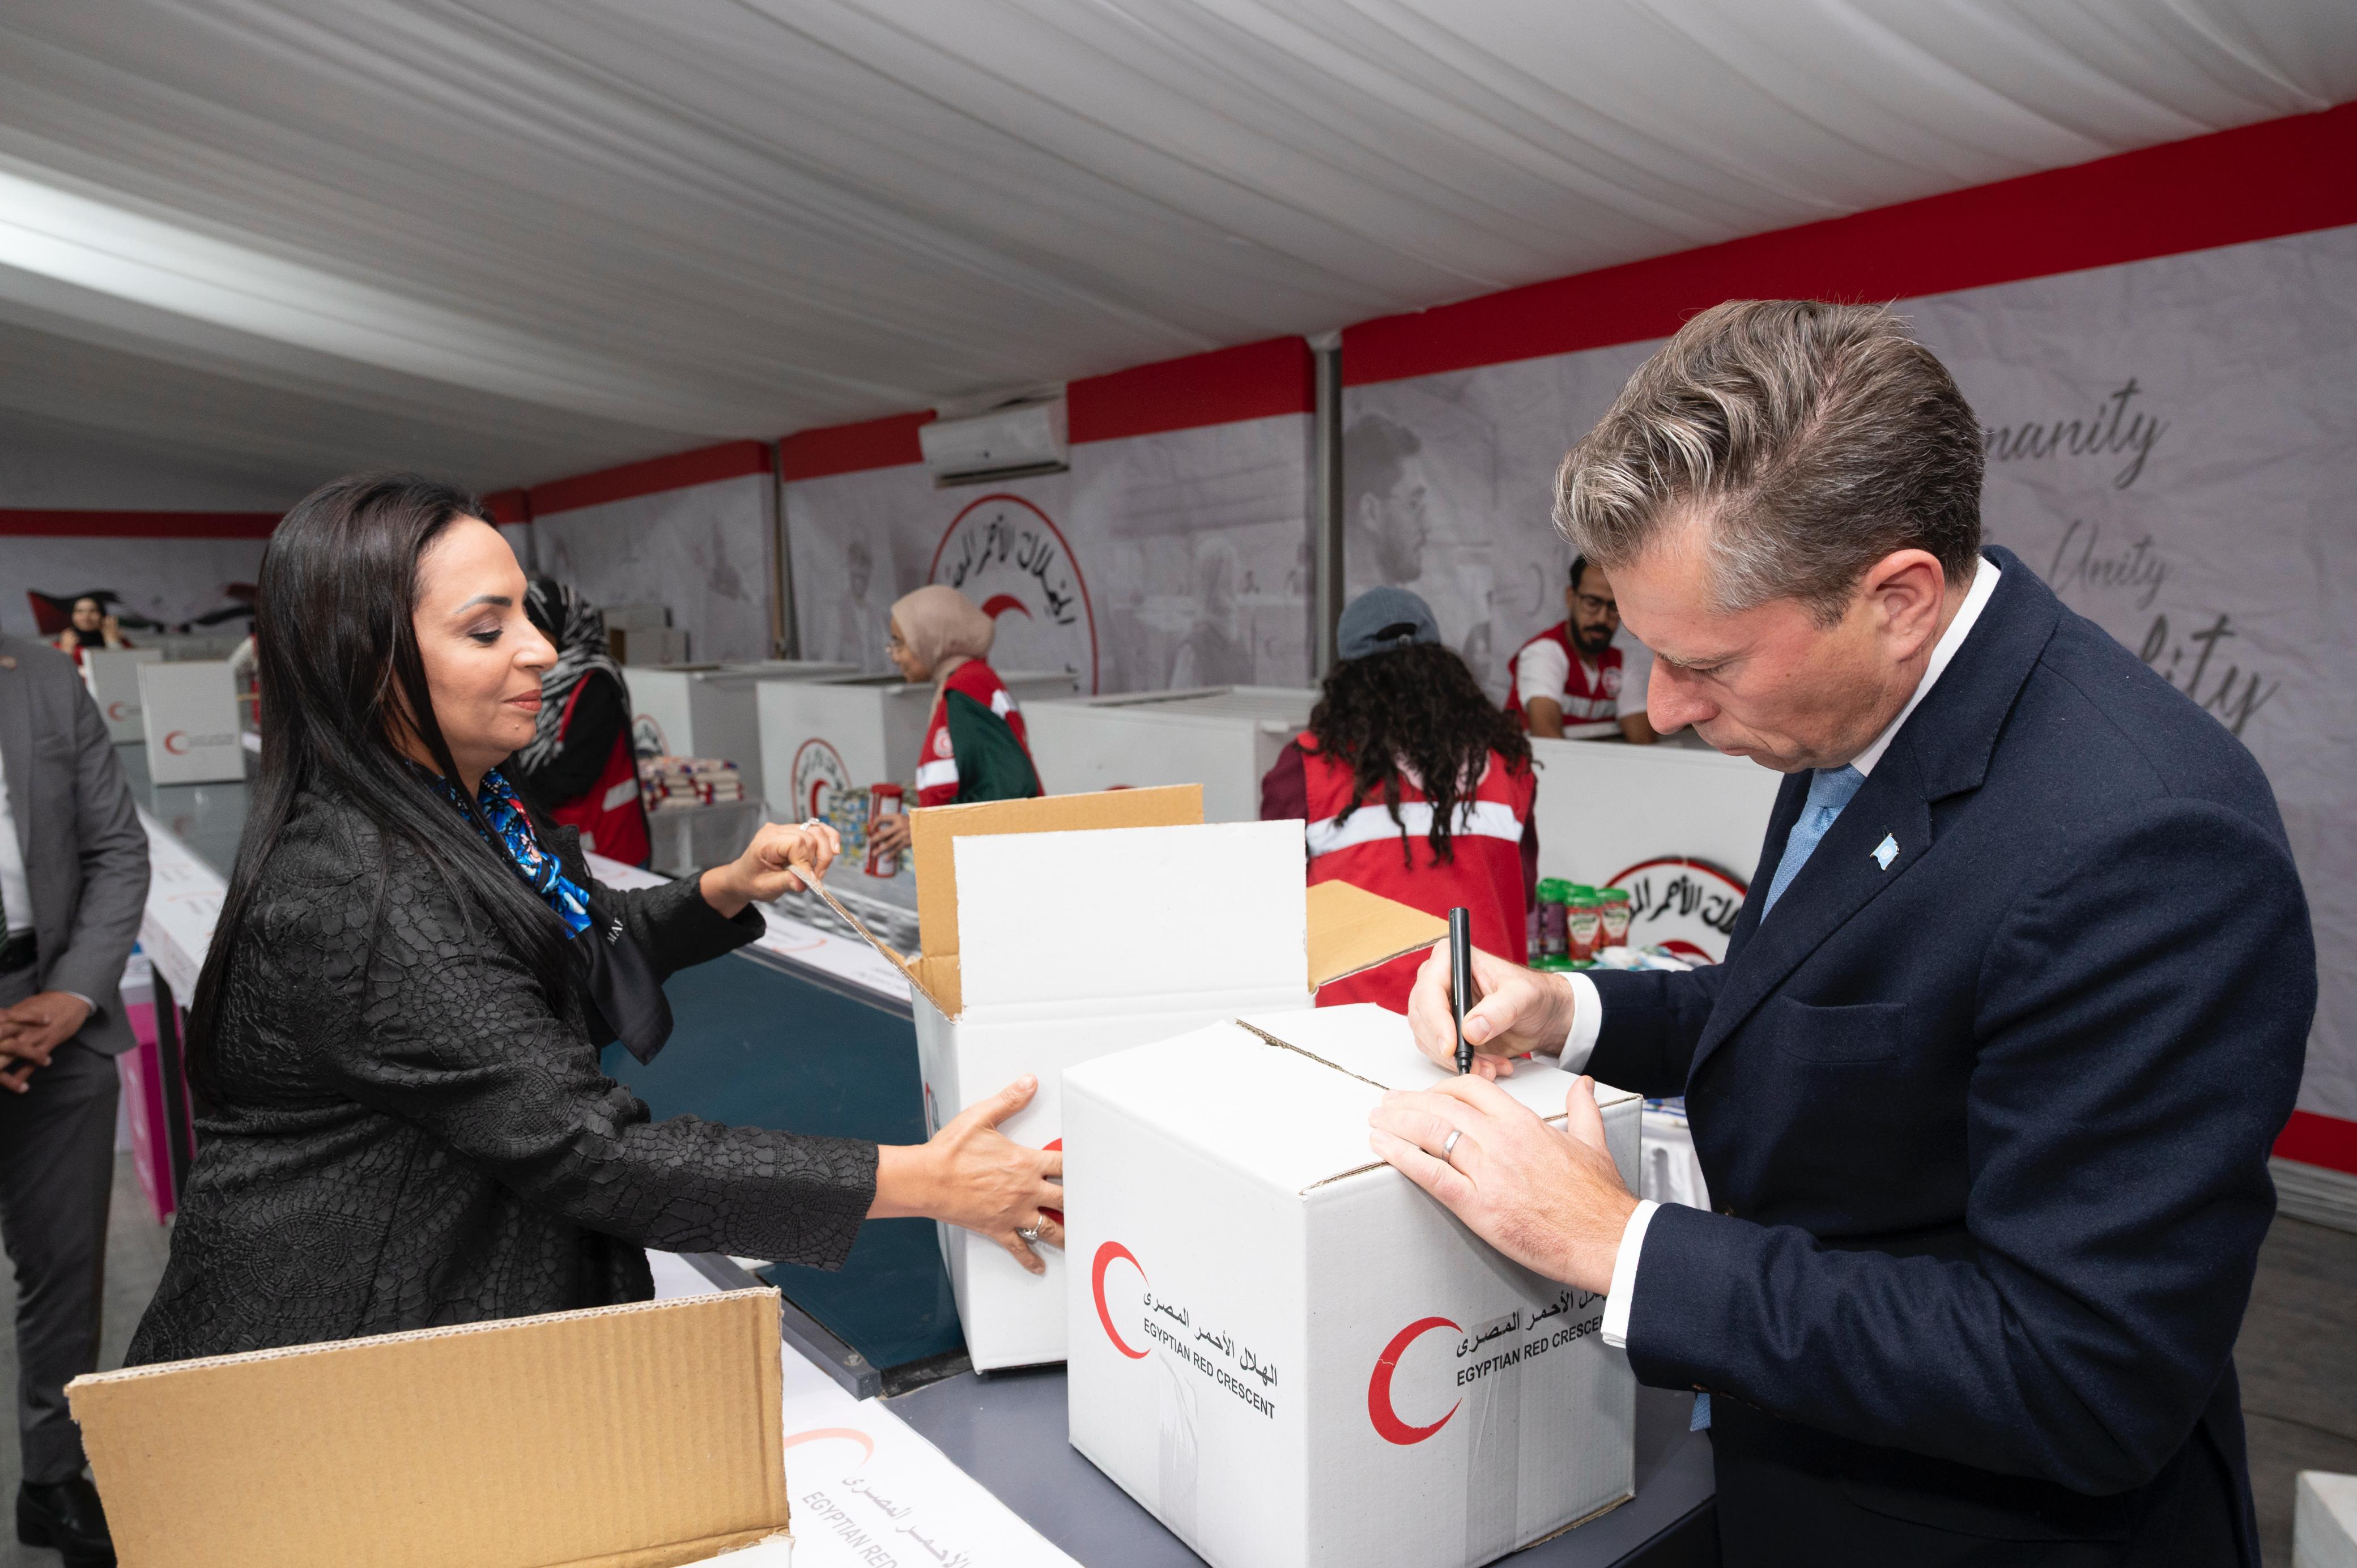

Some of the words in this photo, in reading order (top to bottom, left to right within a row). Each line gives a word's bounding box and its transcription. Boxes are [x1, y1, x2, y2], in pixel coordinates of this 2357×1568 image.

[1985, 377, 2170, 489] manity
[1525, 1289, 1574, 1331] الأحمر
[1144, 1318, 1190, 1362] EGYPTIAN
[1193, 1351, 1214, 1377] RED
[1216, 1368, 1275, 1419] CRESCENT
[1194, 1326, 1235, 1358] الأحمر
[1240, 1347, 1277, 1387] الهلال
[1457, 1348, 1521, 1387] EGYPTIAN
[1524, 1337, 1548, 1360] RED
[1552, 1315, 1603, 1348] CRESCE
[802, 1491, 872, 1549] EGYPTIAN
